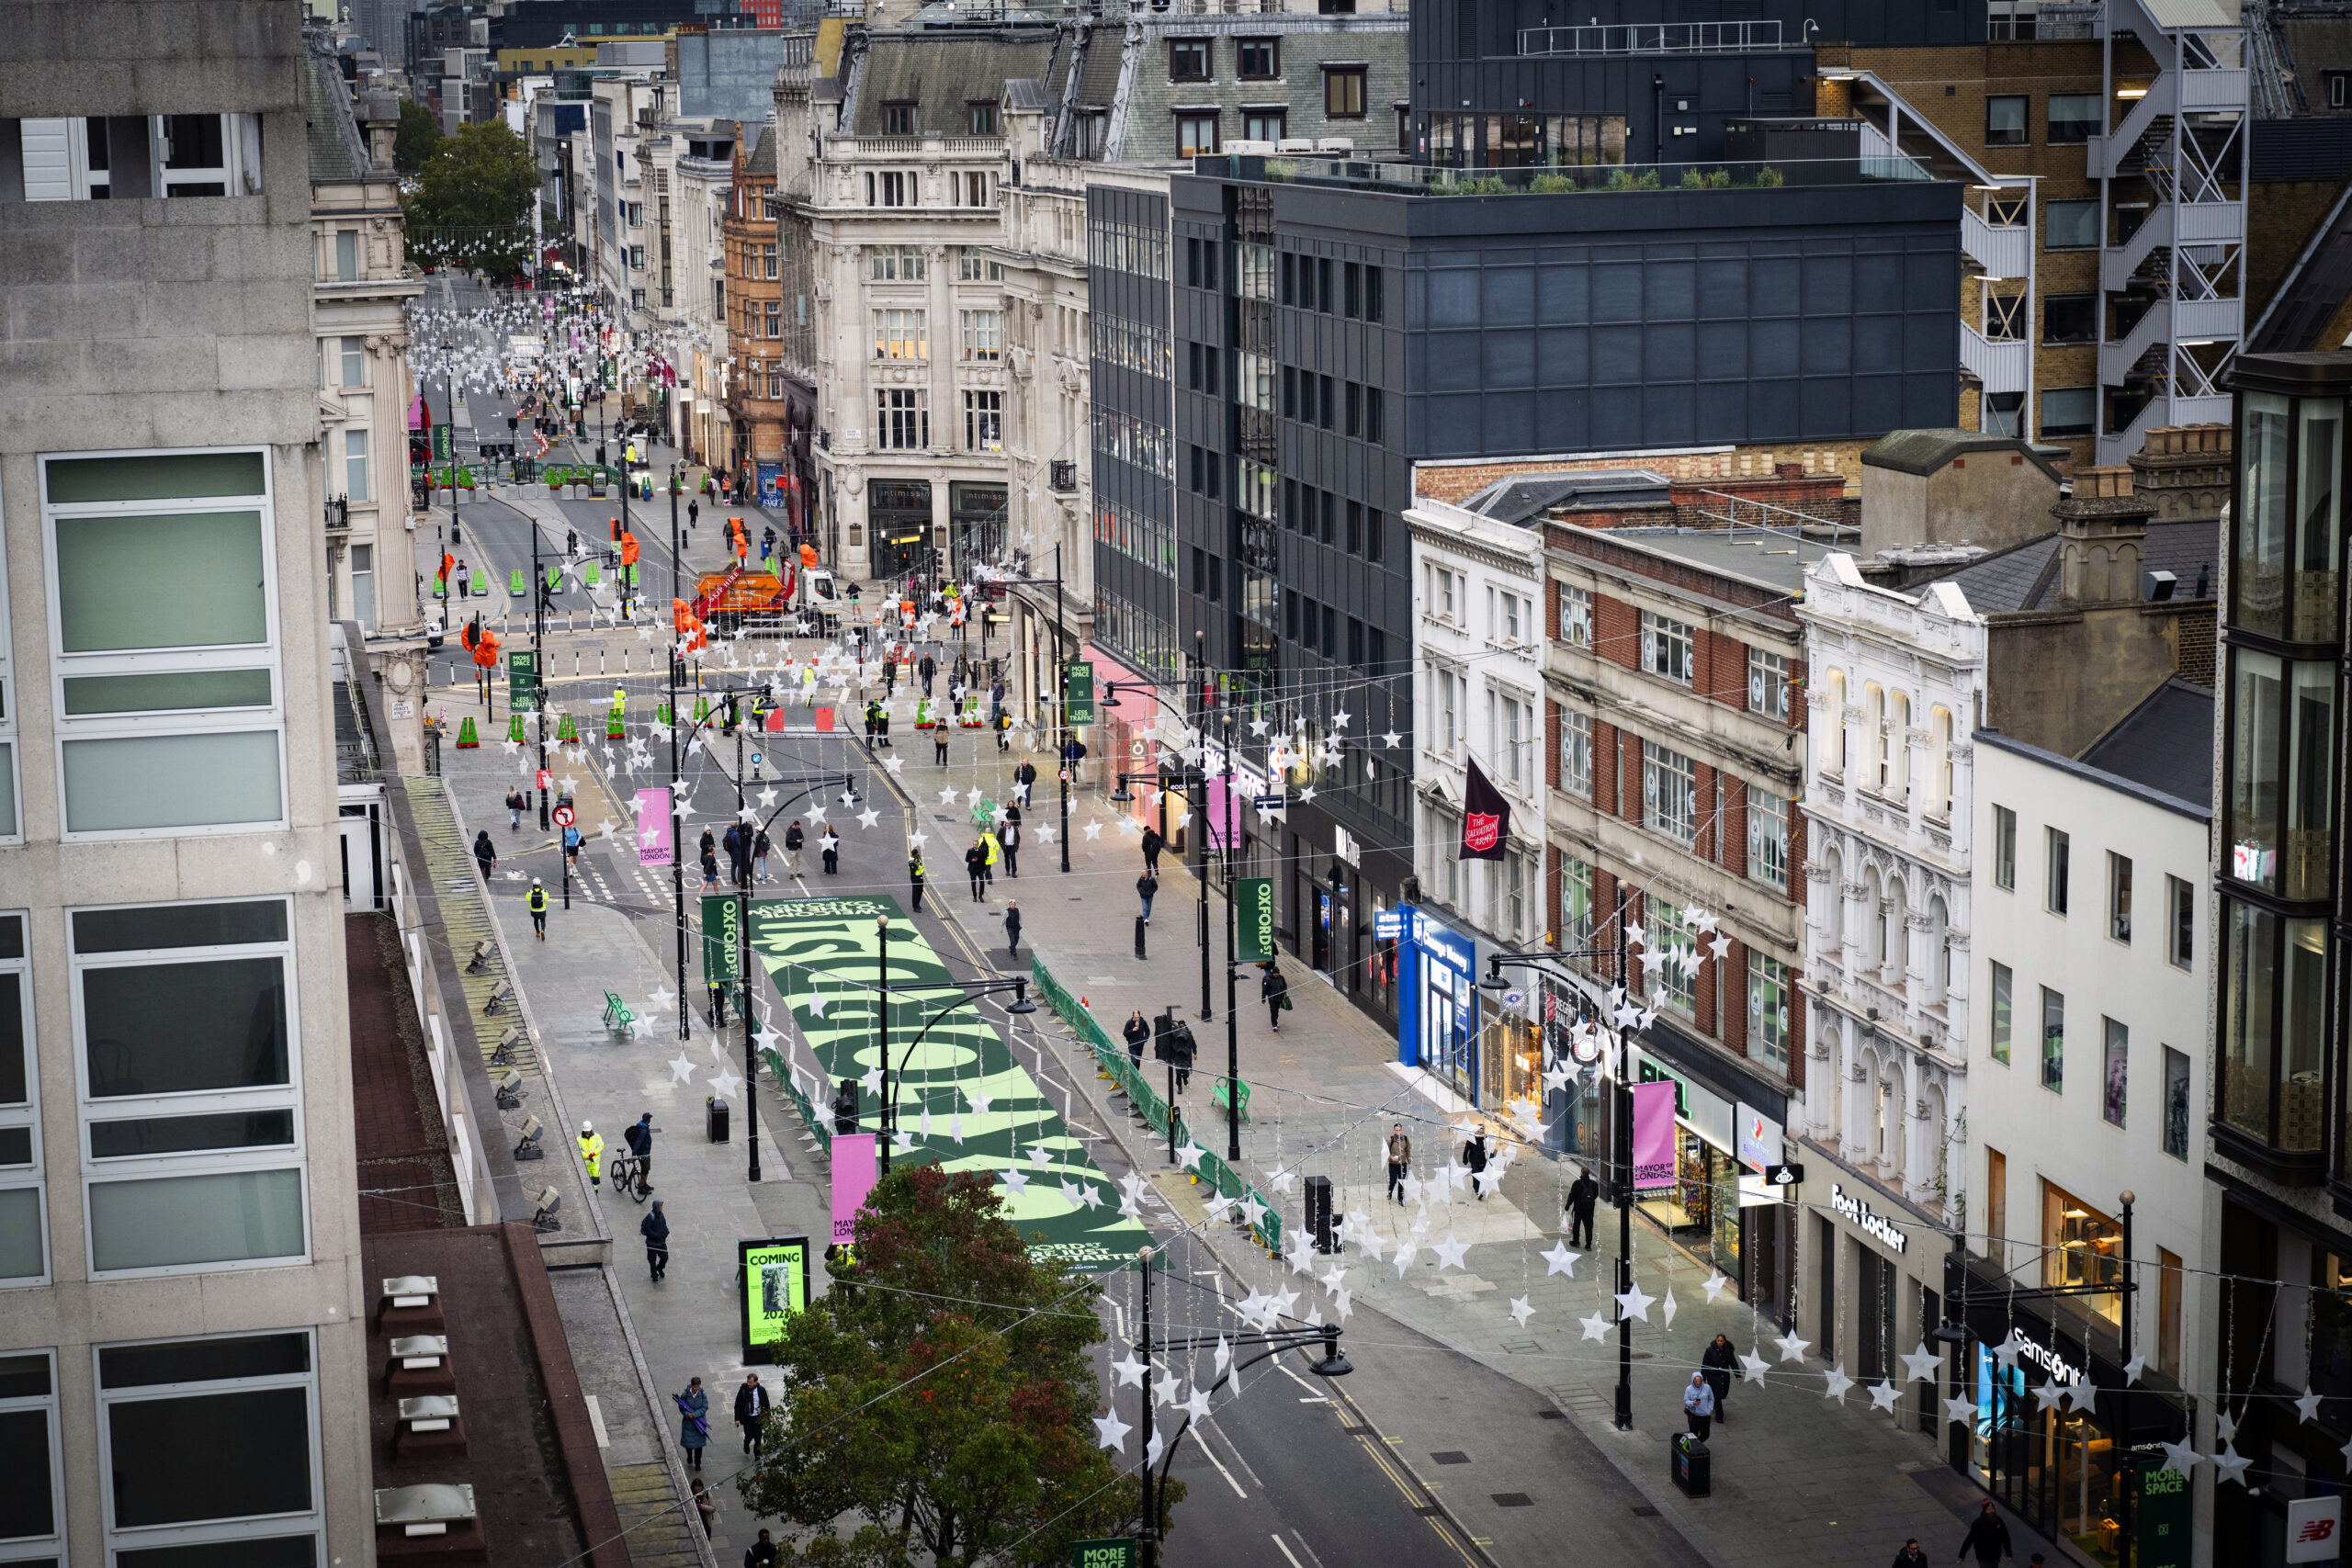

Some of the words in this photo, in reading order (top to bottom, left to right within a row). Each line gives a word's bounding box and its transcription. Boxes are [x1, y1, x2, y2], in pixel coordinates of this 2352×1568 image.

[965, 492, 1007, 501] intimissi
[708, 587, 724, 603] SKIP
[723, 571, 739, 588] HIRE
[1204, 742, 1266, 797] SKEERS
[1473, 817, 1485, 827] THE
[1466, 823, 1497, 840] SALVATION
[1474, 832, 1494, 846] ARMY
[1258, 883, 1272, 945] OXFORD
[1378, 913, 1400, 923] atm
[723, 900, 738, 964] OXFORD
[1376, 924, 1402, 932] Change
[1377, 931, 1401, 939] Money
[1423, 930, 1446, 958] Change
[1635, 1163, 1665, 1171] MAYOR
[1635, 1171, 1674, 1181] LONDON
[834, 1220, 855, 1228] MAY
[1832, 1183, 1859, 1224] Foot
[1860, 1202, 1905, 1254] Locker
[750, 1252, 800, 1265] COMING
[1057, 1253, 1139, 1261] STARTE
[2014, 1326, 2085, 1387] Samsonit
[2145, 1470, 2183, 1483] MORE
[2145, 1481, 2183, 1495] SPACE
[1084, 1548, 1125, 1562] MORE
